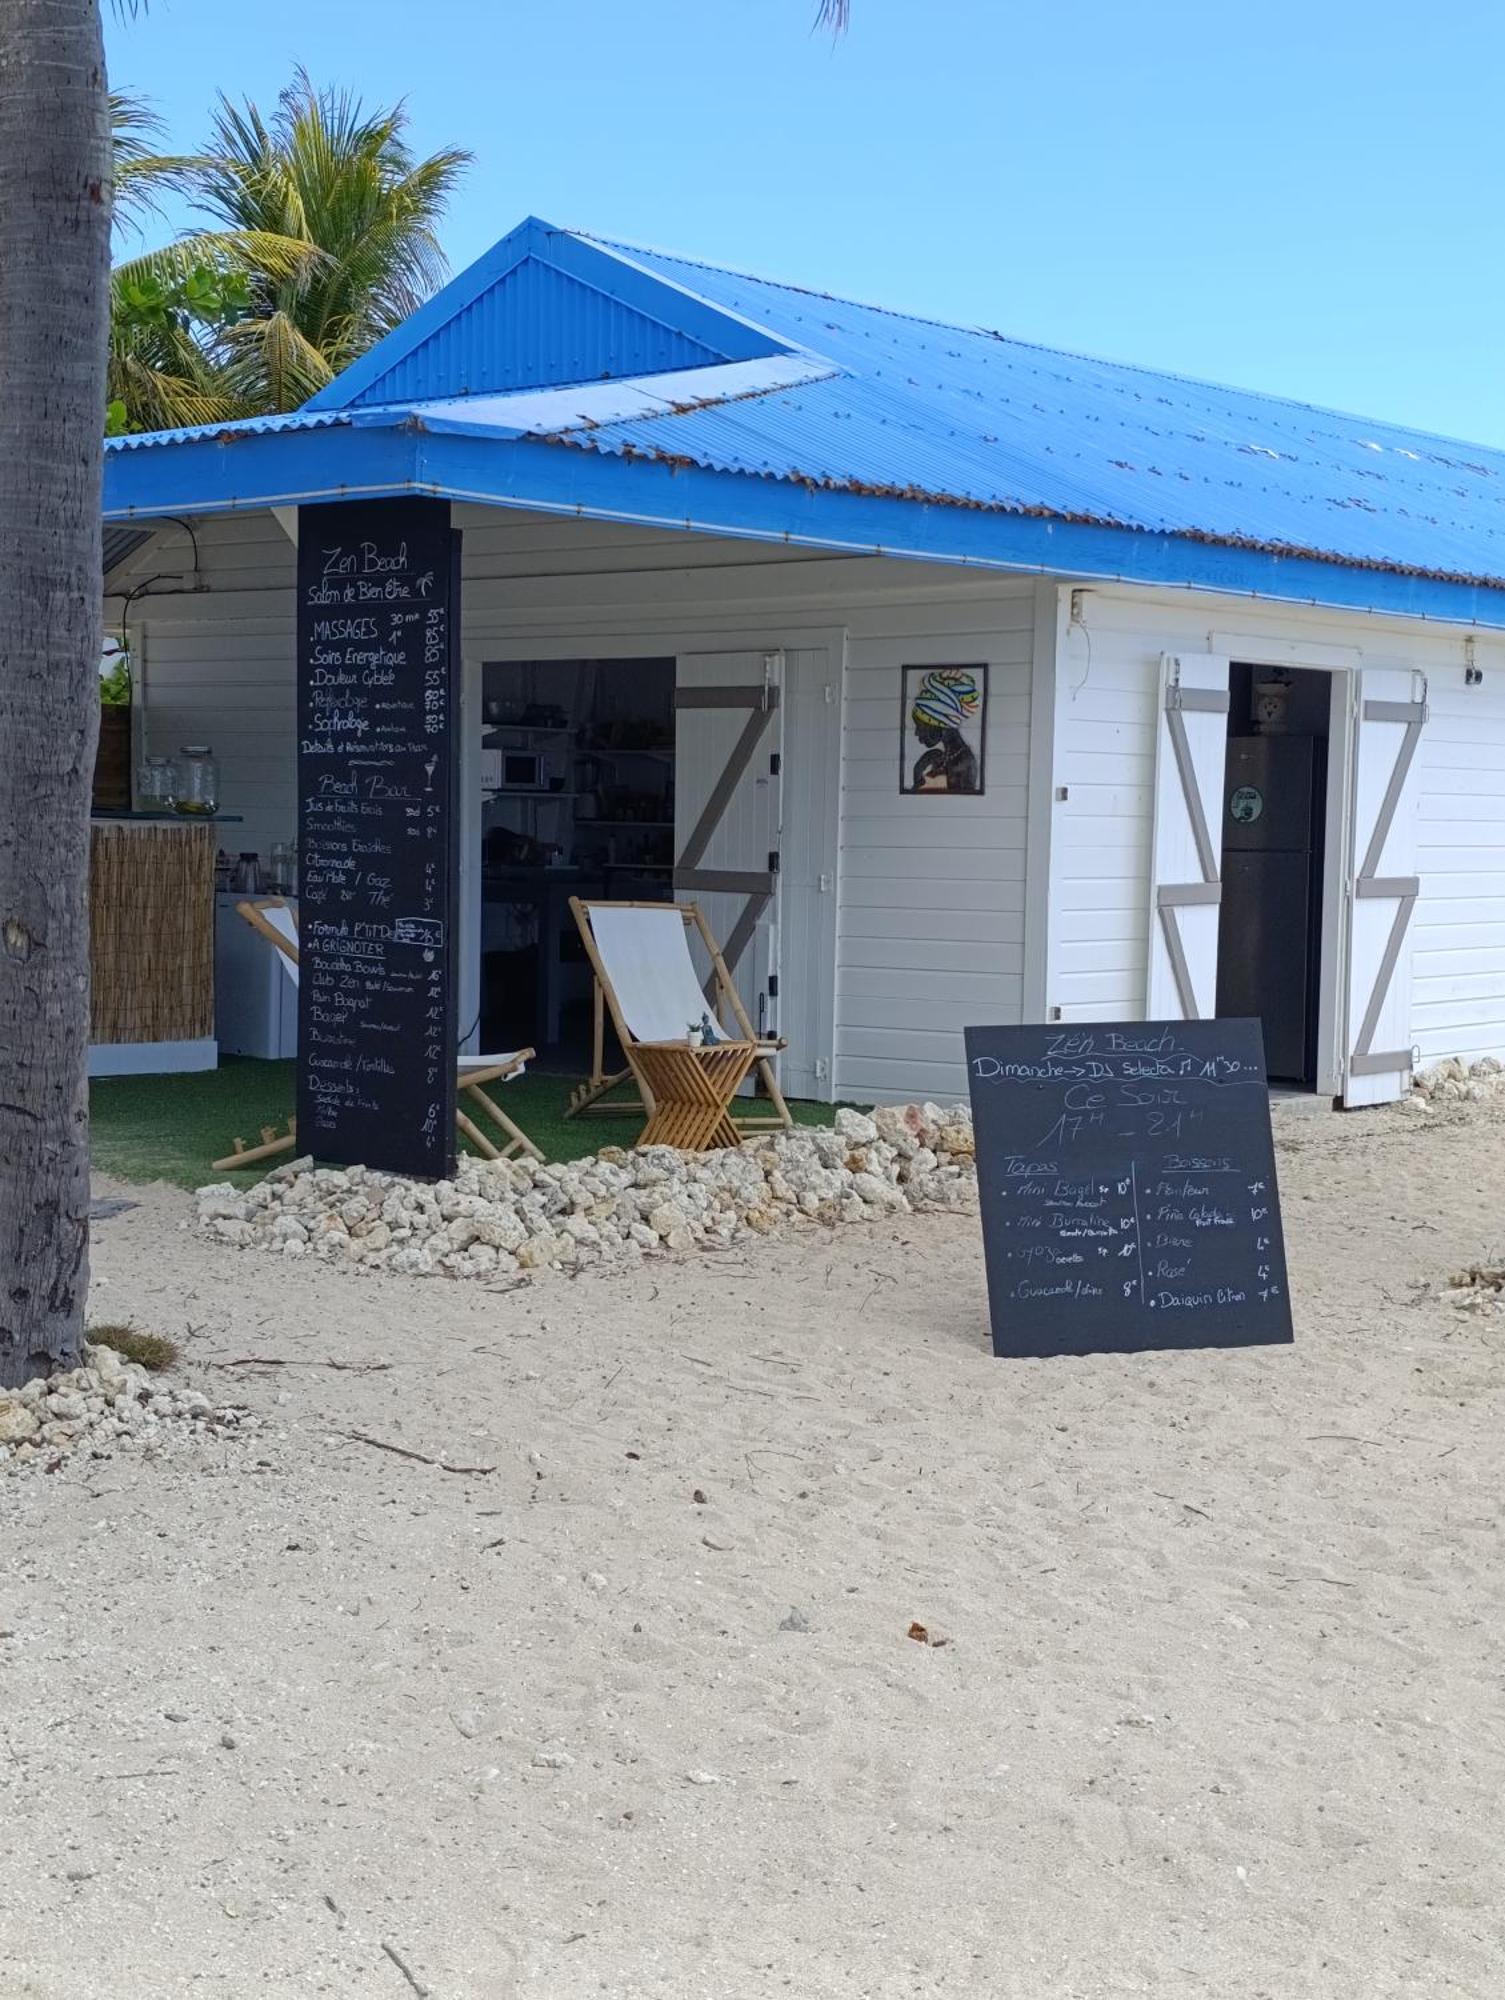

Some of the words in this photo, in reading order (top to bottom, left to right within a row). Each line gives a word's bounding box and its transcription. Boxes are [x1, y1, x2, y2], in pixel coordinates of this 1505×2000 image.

[321, 546, 357, 574] Zen
[360, 541, 407, 573] Beach
[308, 578, 340, 604] Salon
[343, 582, 356, 602] de
[314, 618, 378, 641] MASSAGES
[390, 613, 404, 625] 30
[314, 646, 341, 665] Soins
[319, 769, 358, 797] Beach
[366, 872, 392, 888] Gaz
[312, 939, 320, 950] A
[340, 975, 360, 989] Zen
[972, 1057, 1063, 1078] Dimanche
[1064, 1084, 1105, 1110] Ce
[1117, 1084, 1188, 1107] Soir
[1004, 1156, 1058, 1177] Tapas
